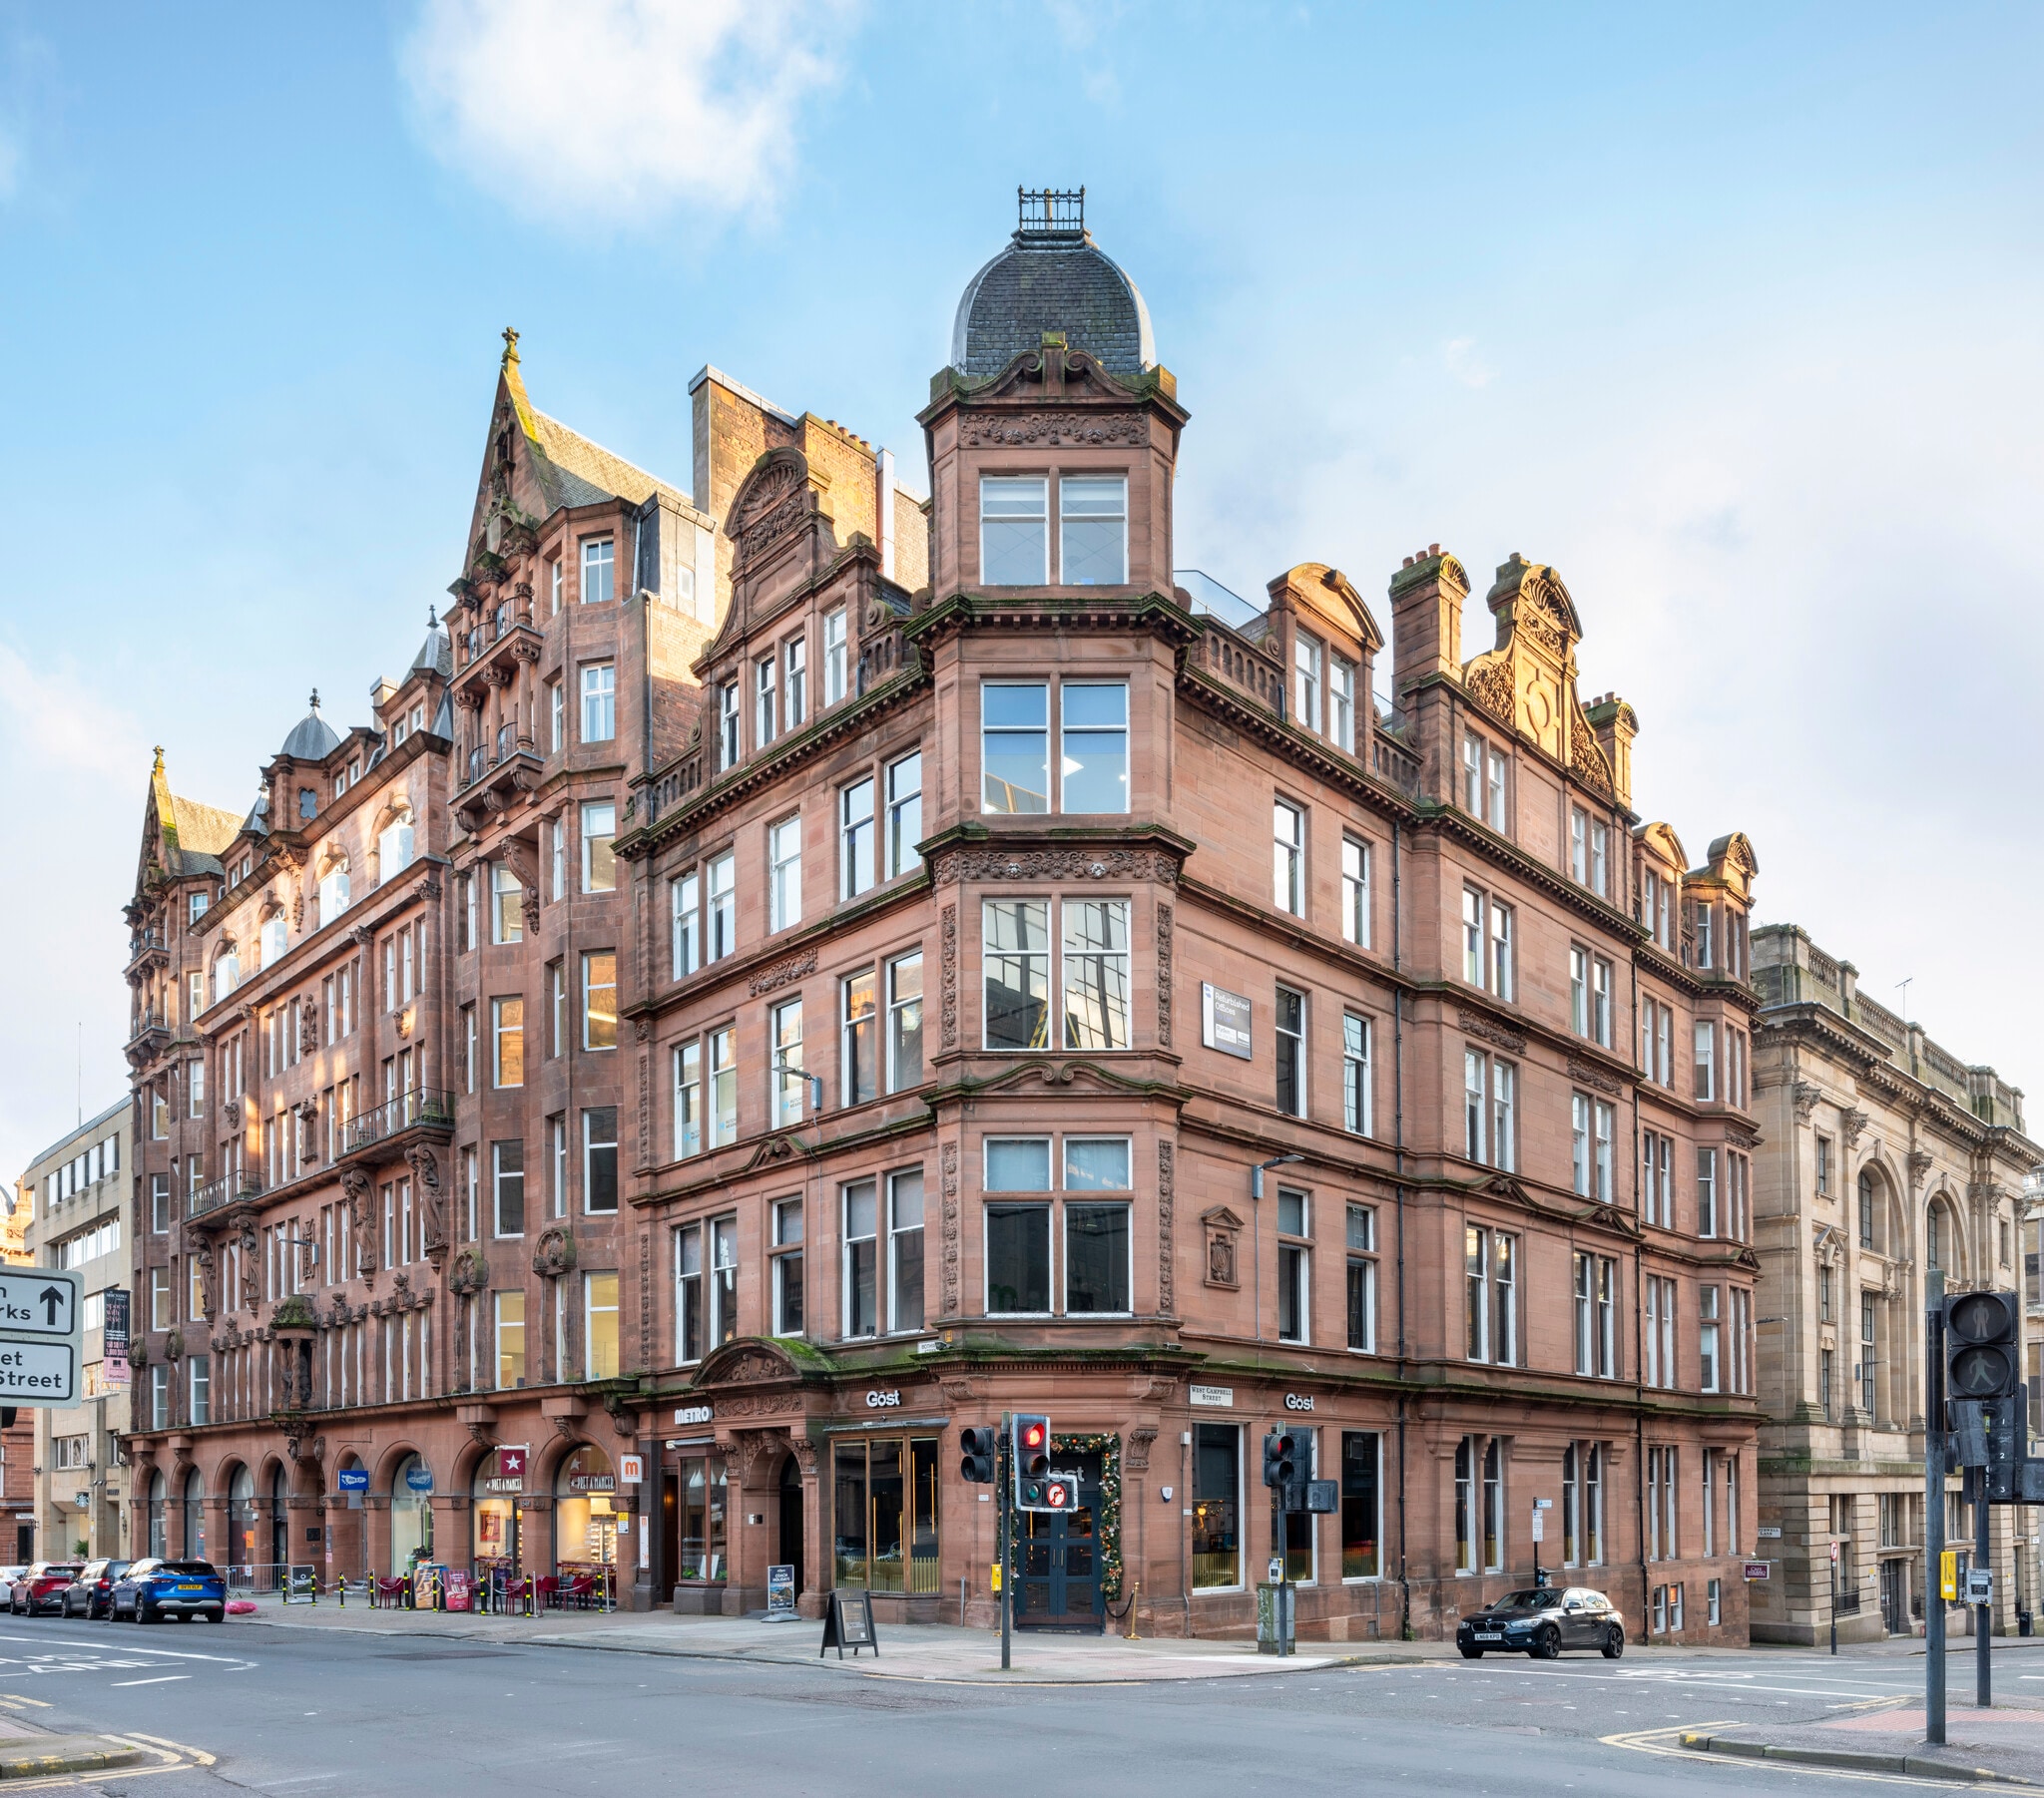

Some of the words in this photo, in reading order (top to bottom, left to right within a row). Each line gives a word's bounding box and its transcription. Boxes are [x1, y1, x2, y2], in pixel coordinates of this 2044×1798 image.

[1215, 992, 1250, 1012] Refurbished
[1215, 1002, 1236, 1016] Offices
[1202, 1393, 1222, 1402] STREET
[675, 1406, 712, 1425] METRO
[577, 1476, 589, 1489] PRET
[594, 1476, 614, 1490] MANGER
